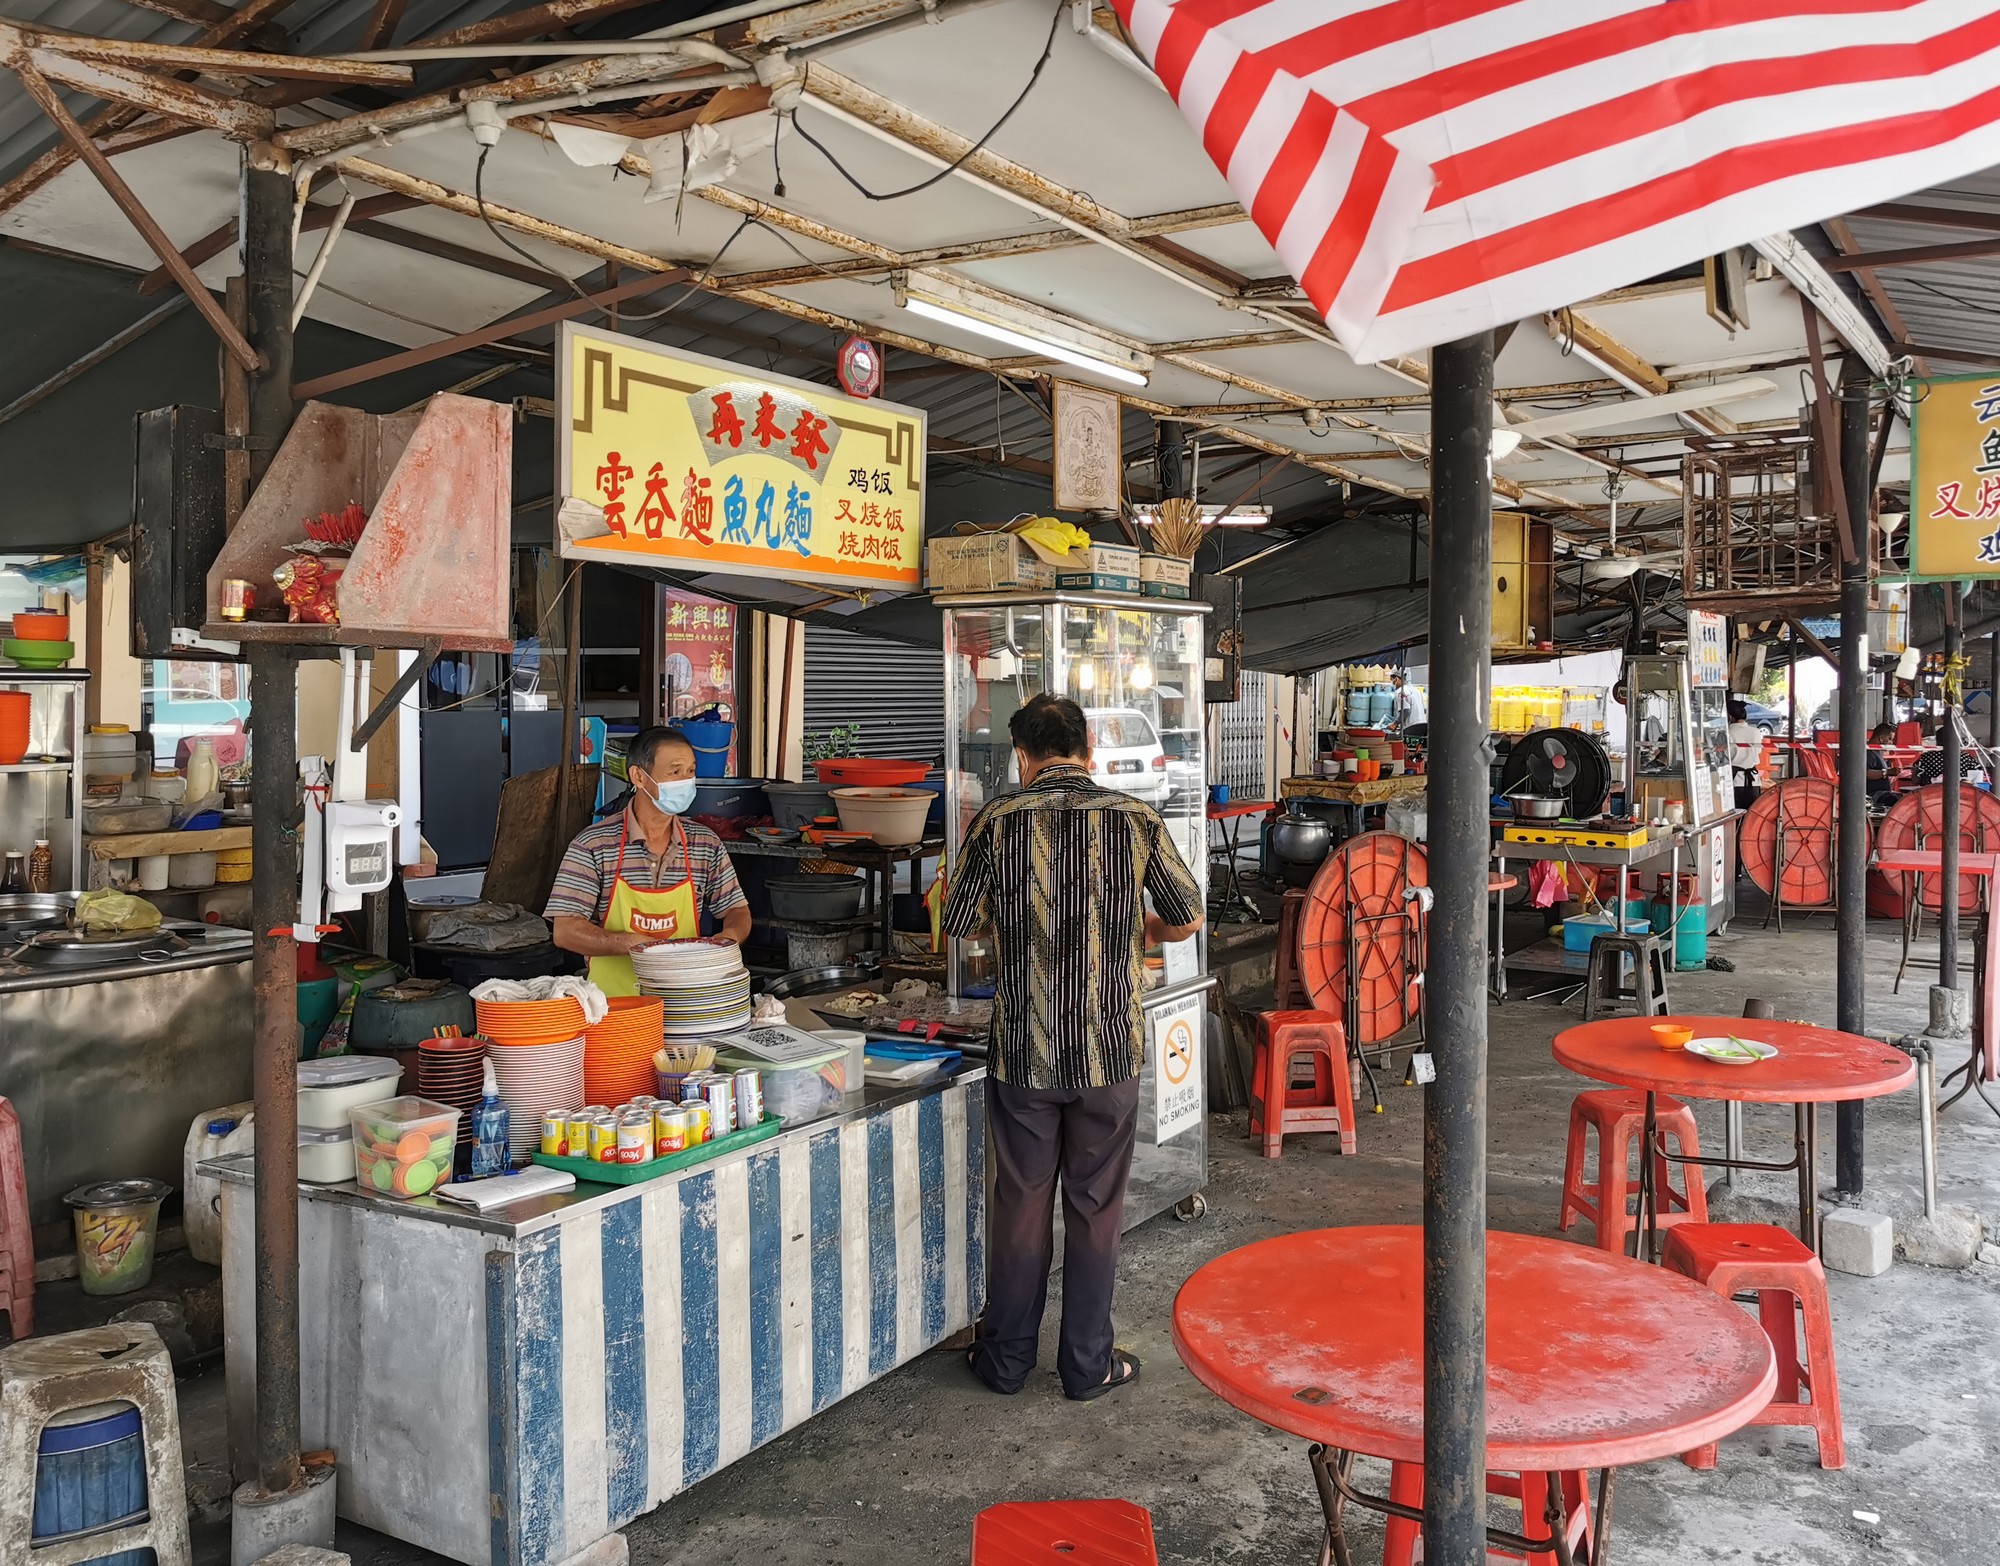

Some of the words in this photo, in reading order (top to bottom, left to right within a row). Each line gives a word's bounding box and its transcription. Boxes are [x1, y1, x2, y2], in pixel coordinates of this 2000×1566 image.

[847, 467, 893, 495] 鸡饭
[834, 499, 905, 532] 叉烧饭
[838, 531, 902, 561] 烧肉饭
[667, 601, 730, 632] 新興旺
[633, 913, 675, 930] TUMIX
[1159, 1114, 1169, 1127] NO
[1170, 1099, 1200, 1122] SMOKING
